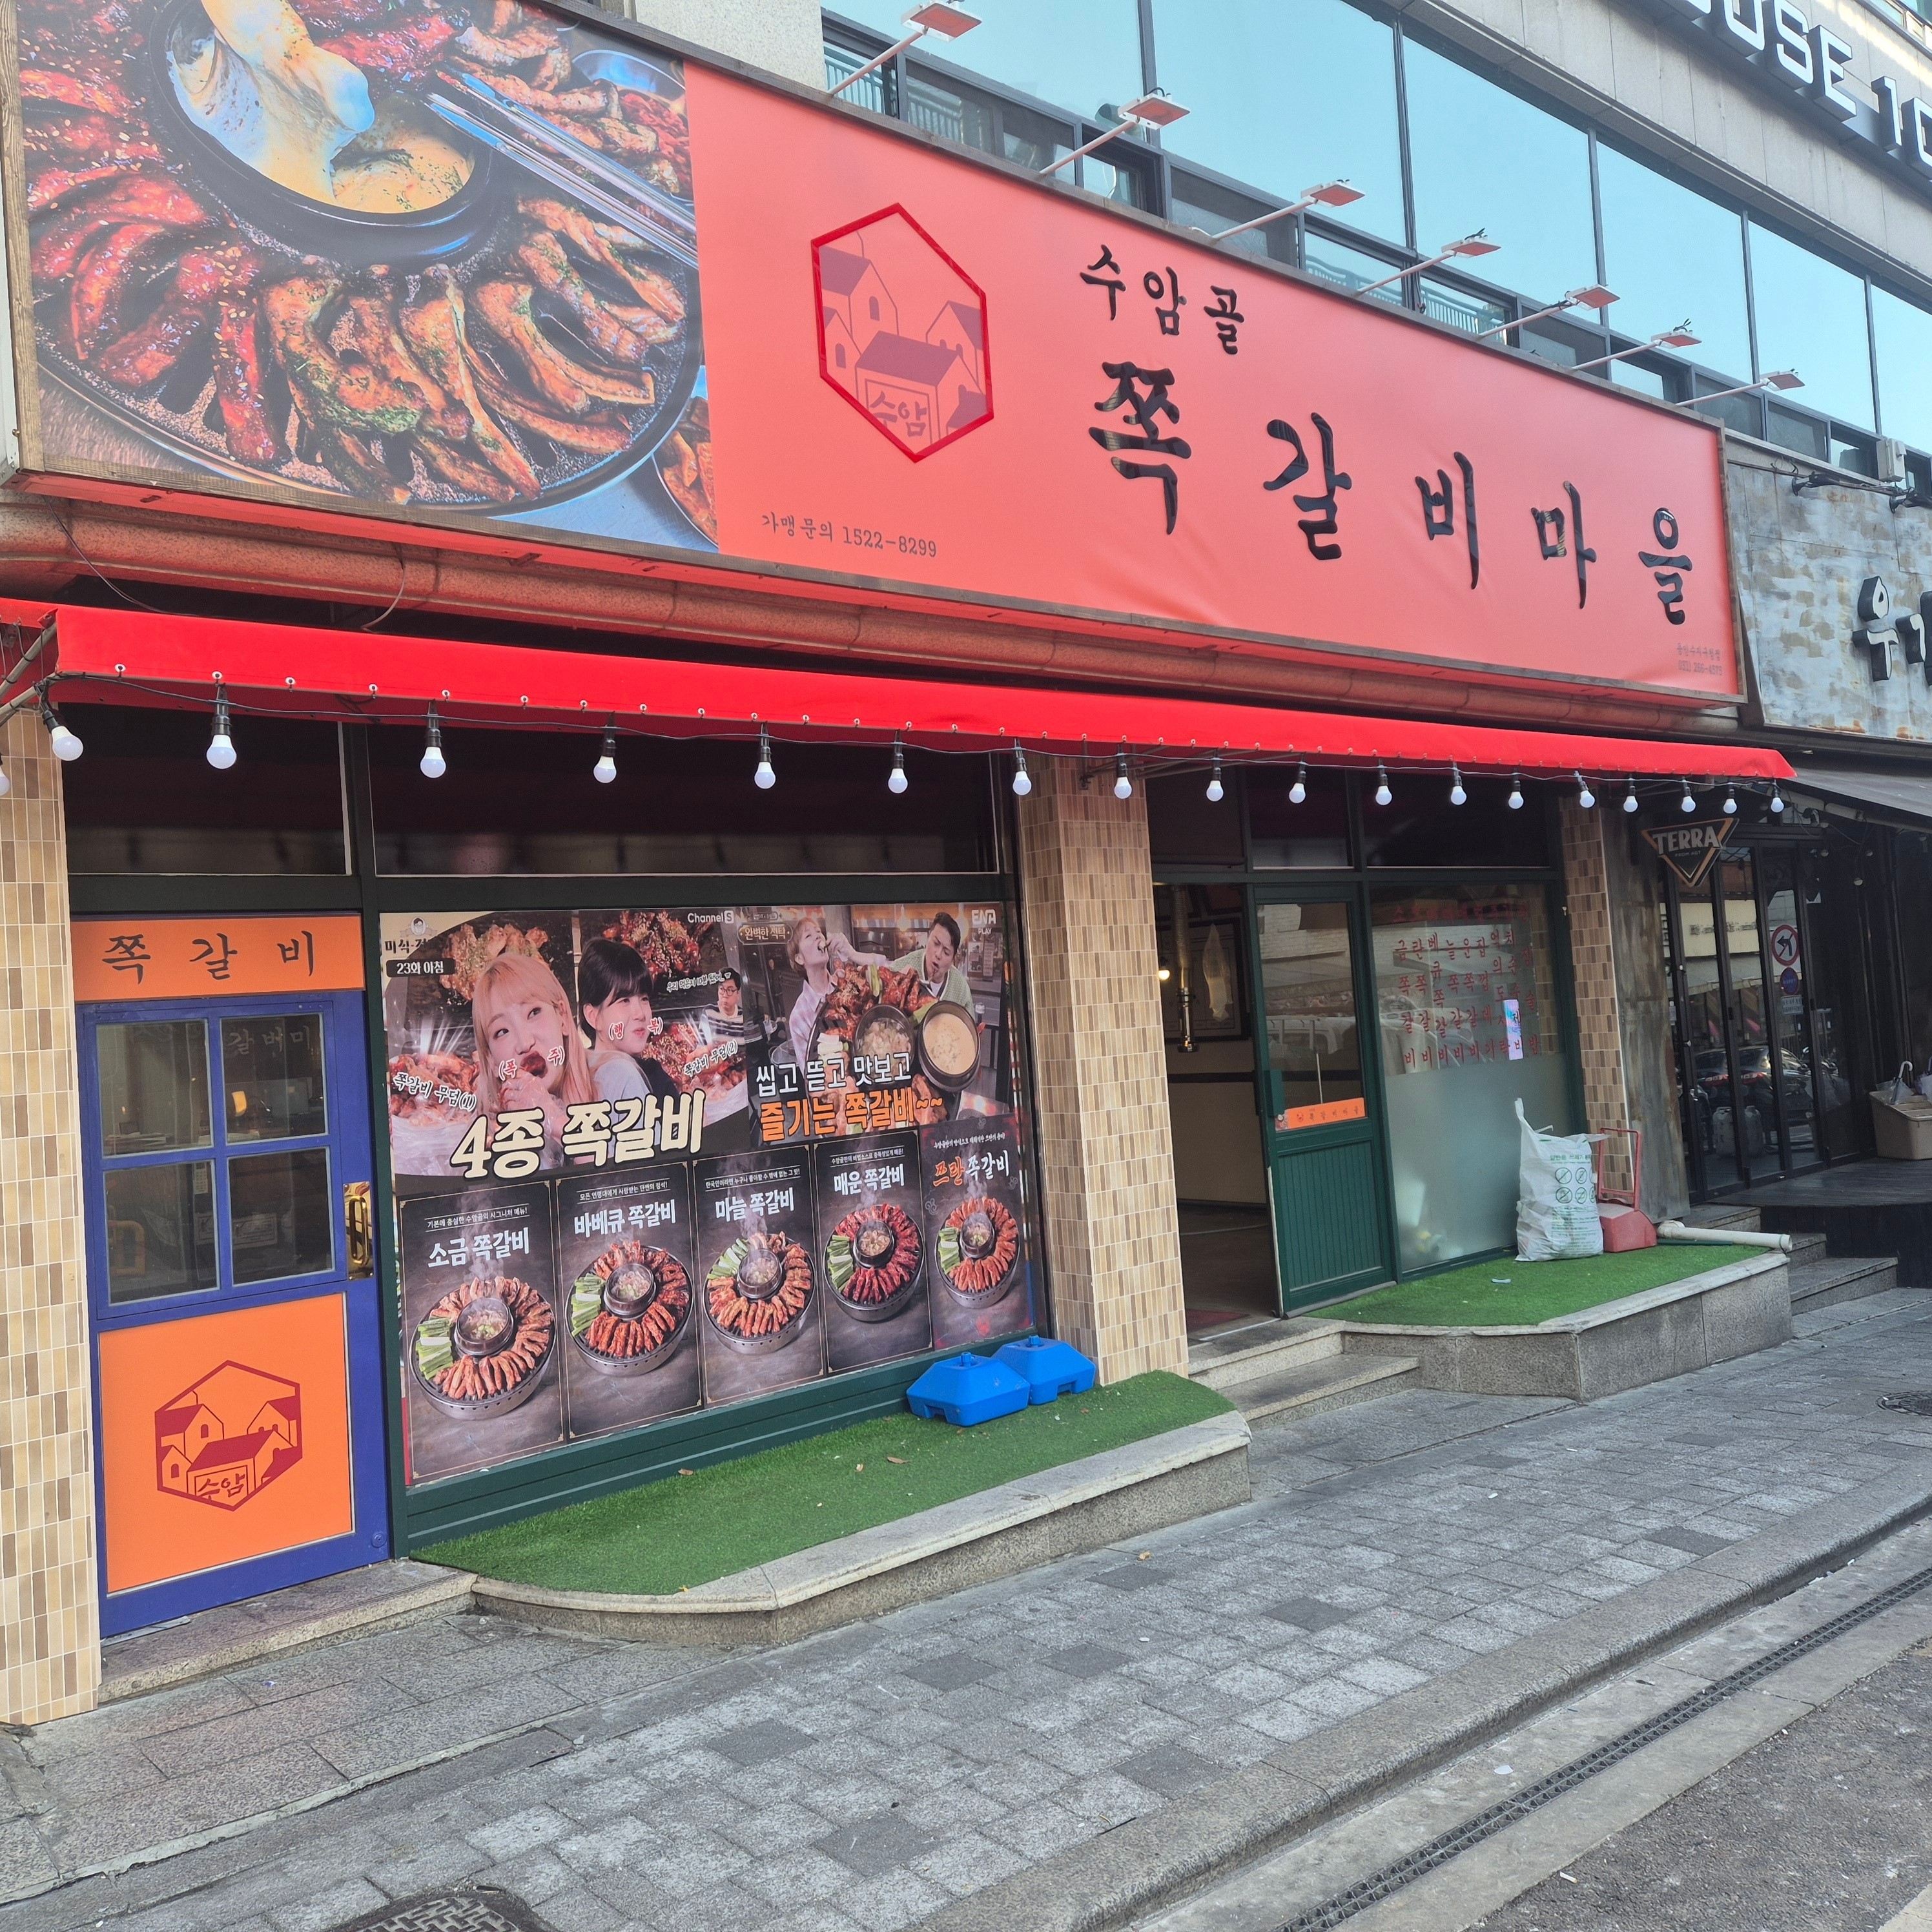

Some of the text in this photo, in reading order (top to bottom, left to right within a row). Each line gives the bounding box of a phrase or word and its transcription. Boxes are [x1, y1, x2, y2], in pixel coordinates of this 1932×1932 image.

[1678, 0, 1857, 123] USE
[1080, 244, 1244, 355] 수암골
[1089, 361, 1692, 625] 쪽갈비마을
[762, 512, 936, 557] 가맹 문의 1522-8299
[1653, 826, 1719, 854] TERRA
[687, 912, 723, 923] Channel
[745, 927, 769, 940] 완벽한
[972, 909, 996, 924] ENA
[102, 930, 314, 984] 쪽갈비
[396, 960, 444, 974] 23화 아침
[666, 981, 678, 992] 우리
[498, 1045, 565, 1081] (폭 주)
[684, 1040, 738, 1077] 쪽갈비 무덤(2)
[756, 1052, 912, 1098] 씹고 뜯고 맛보고
[393, 1072, 477, 1112] 쪽갈비 무덤(1)
[450, 1089, 706, 1180] 4종 쪽갈비
[760, 1097, 837, 1142] 즐기는
[734, 1175, 748, 1184] 누구나
[834, 1163, 905, 1195] 매운 쪽갈비
[965, 1149, 1009, 1181] 쪽갈비
[427, 1207, 528, 1228] 기본에 충실한 수암골의 시그니처 메뉴!
[574, 1199, 676, 1238] 바베큐 쪽갈비
[715, 1187, 794, 1222] 마늘 쪽갈비
[427, 1227, 529, 1268] 소금 쪽갈비
